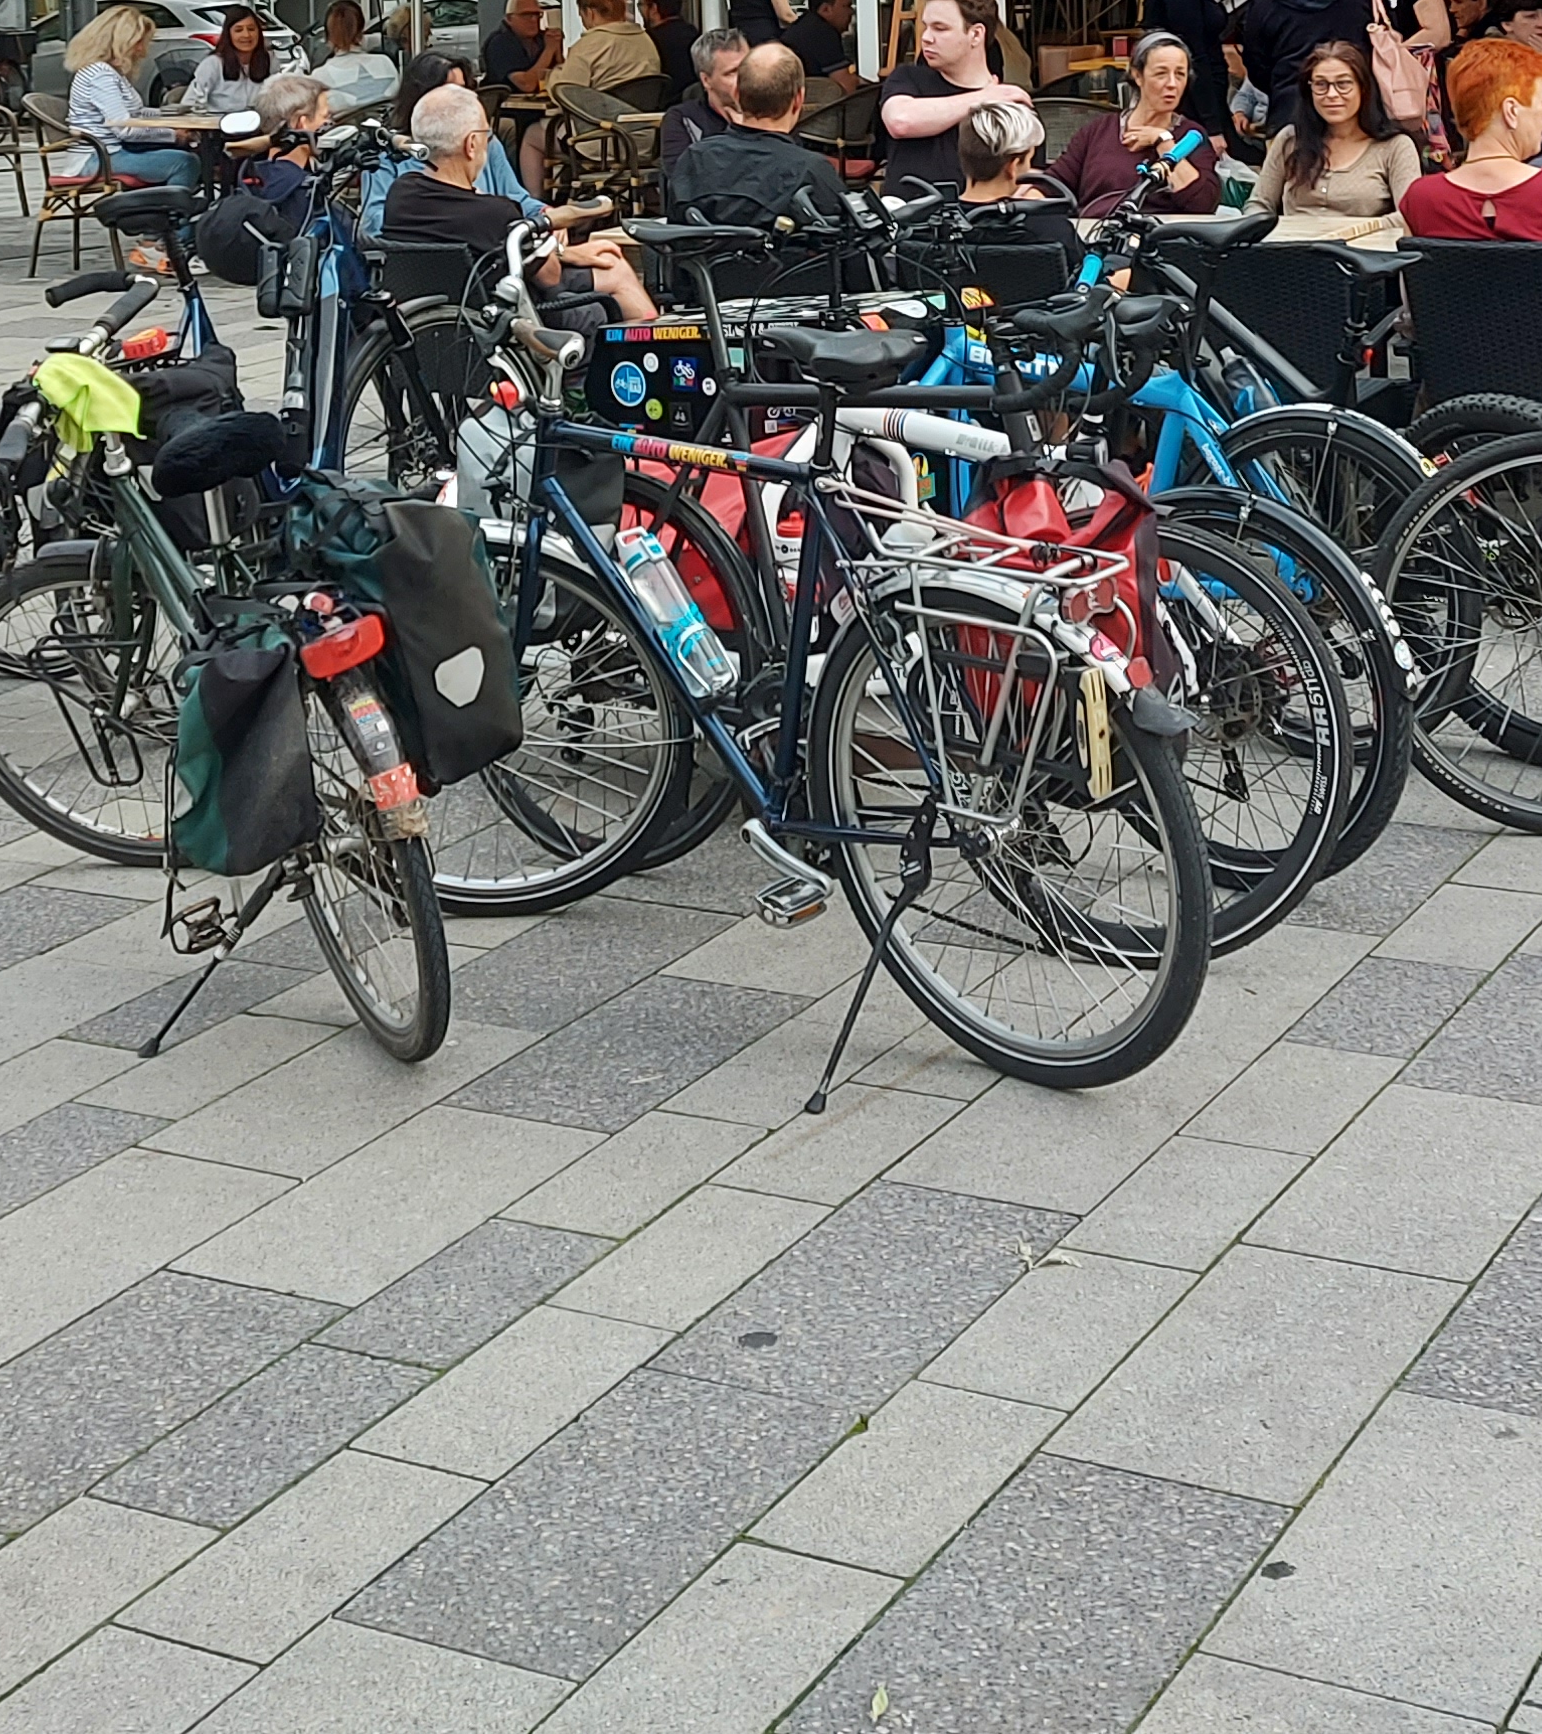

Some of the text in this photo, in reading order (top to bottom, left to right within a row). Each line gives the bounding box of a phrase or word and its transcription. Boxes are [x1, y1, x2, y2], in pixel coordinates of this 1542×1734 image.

[606, 326, 701, 342] EIN AUTO WENIGER.
[611, 434, 636, 453] EIN
[668, 444, 729, 469] WENIGER.
